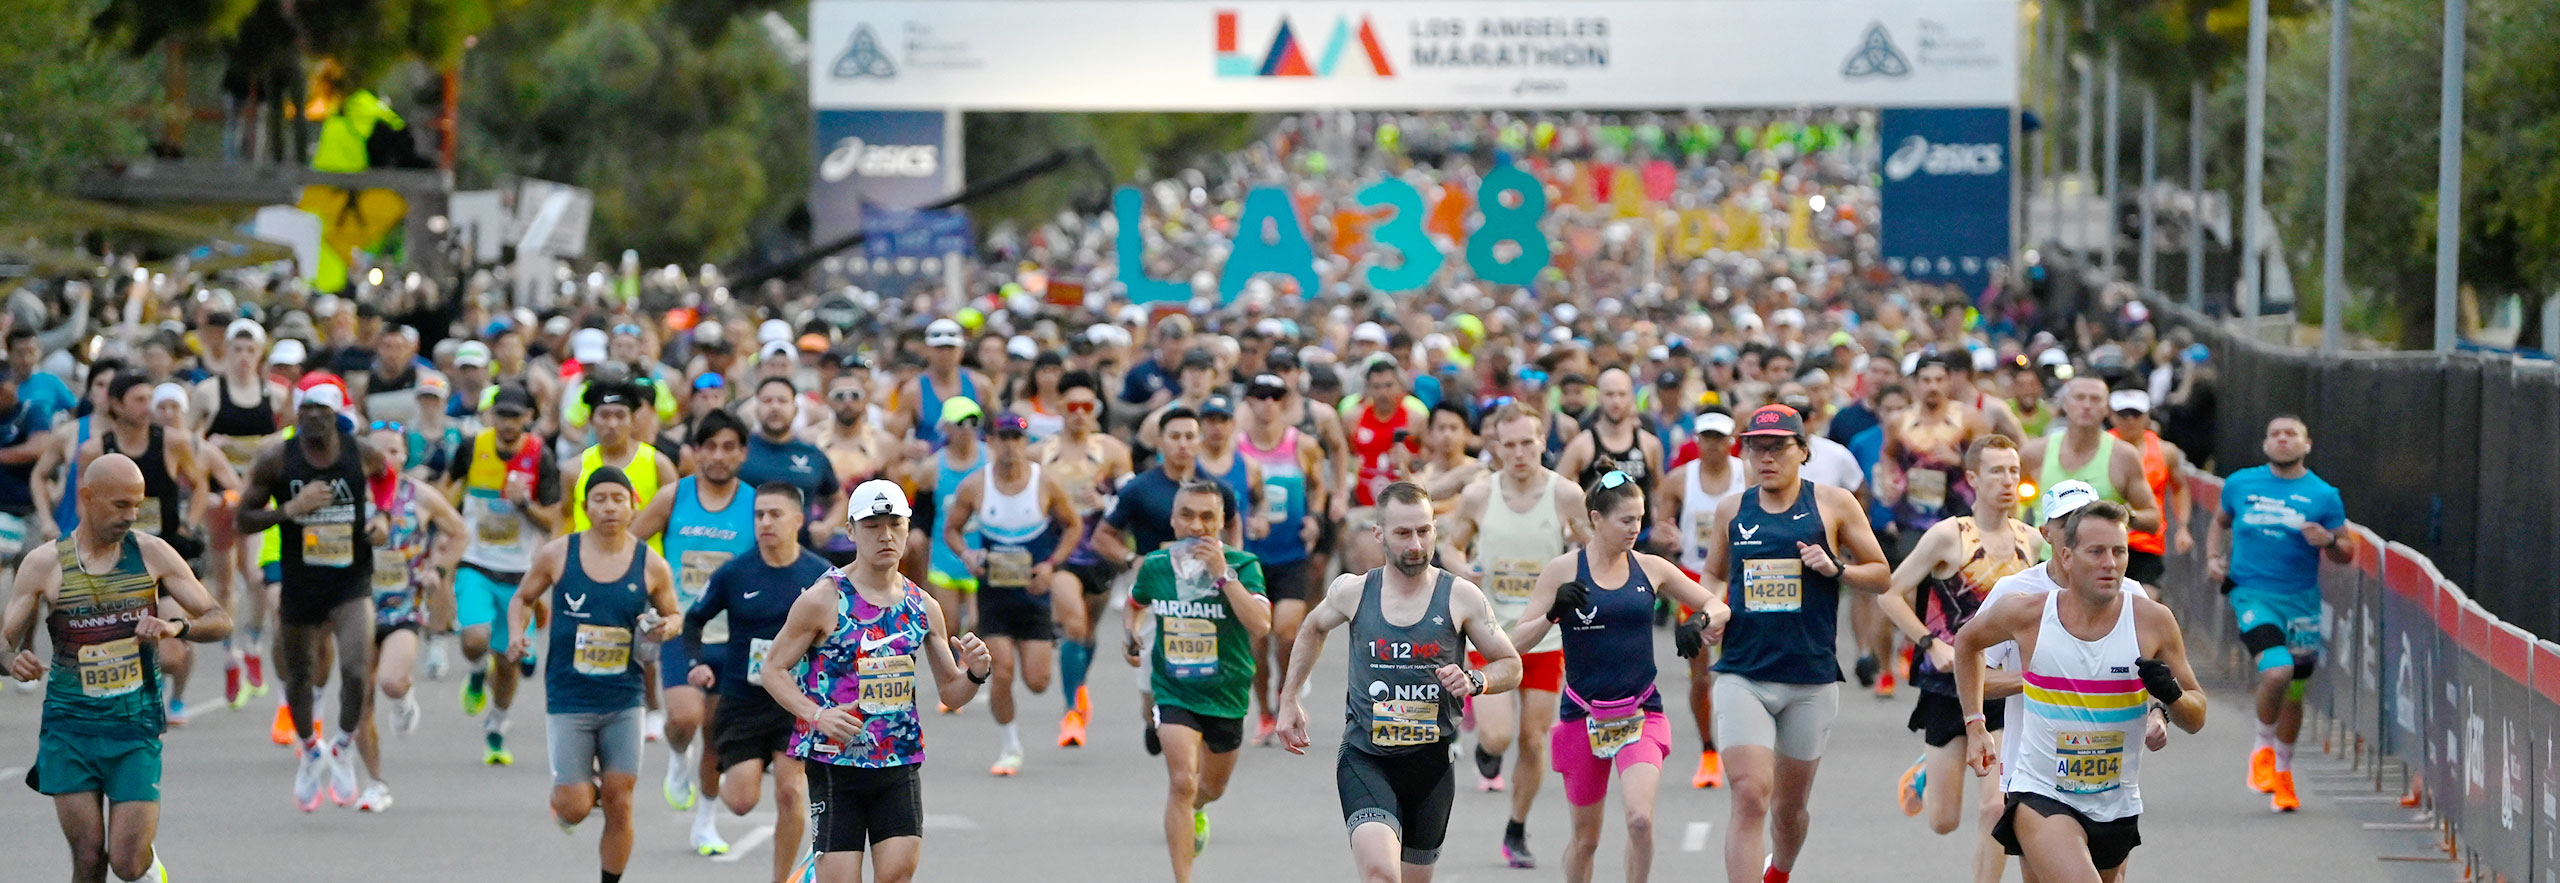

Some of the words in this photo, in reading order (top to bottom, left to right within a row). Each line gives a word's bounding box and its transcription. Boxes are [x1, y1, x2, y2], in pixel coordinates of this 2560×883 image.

[1409, 18, 1465, 38] LOS
[1477, 18, 1610, 38] ANGELES
[1410, 42, 1610, 67] MARATHON
[1746, 571, 1752, 582] A
[1750, 583, 1797, 598] 14220
[68, 614, 118, 629] RUNNING
[85, 664, 138, 686] B3375
[863, 681, 911, 700] A1304
[1395, 684, 1440, 701] NKR
[1377, 726, 1435, 742] A1255
